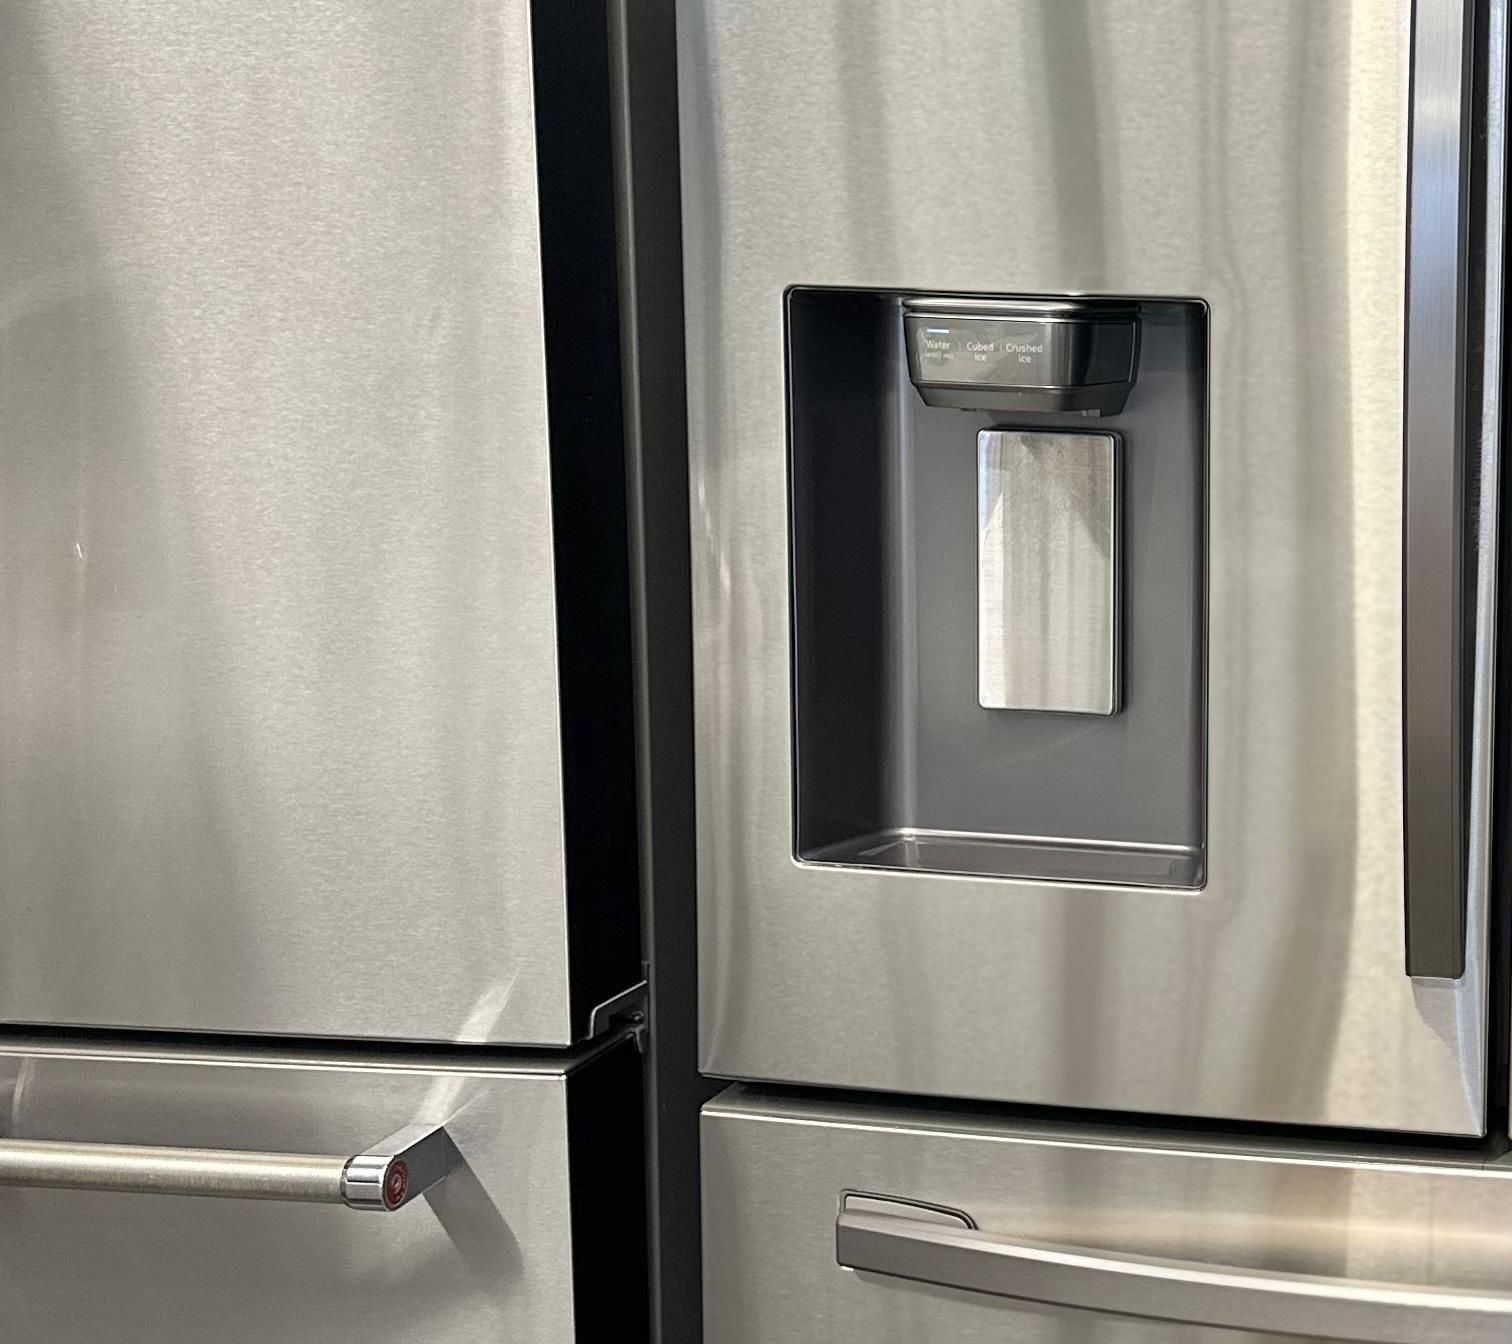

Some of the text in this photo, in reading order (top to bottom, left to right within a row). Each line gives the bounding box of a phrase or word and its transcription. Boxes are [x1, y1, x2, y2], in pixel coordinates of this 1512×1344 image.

[926, 339, 1043, 353] Water Cubed Crushed
